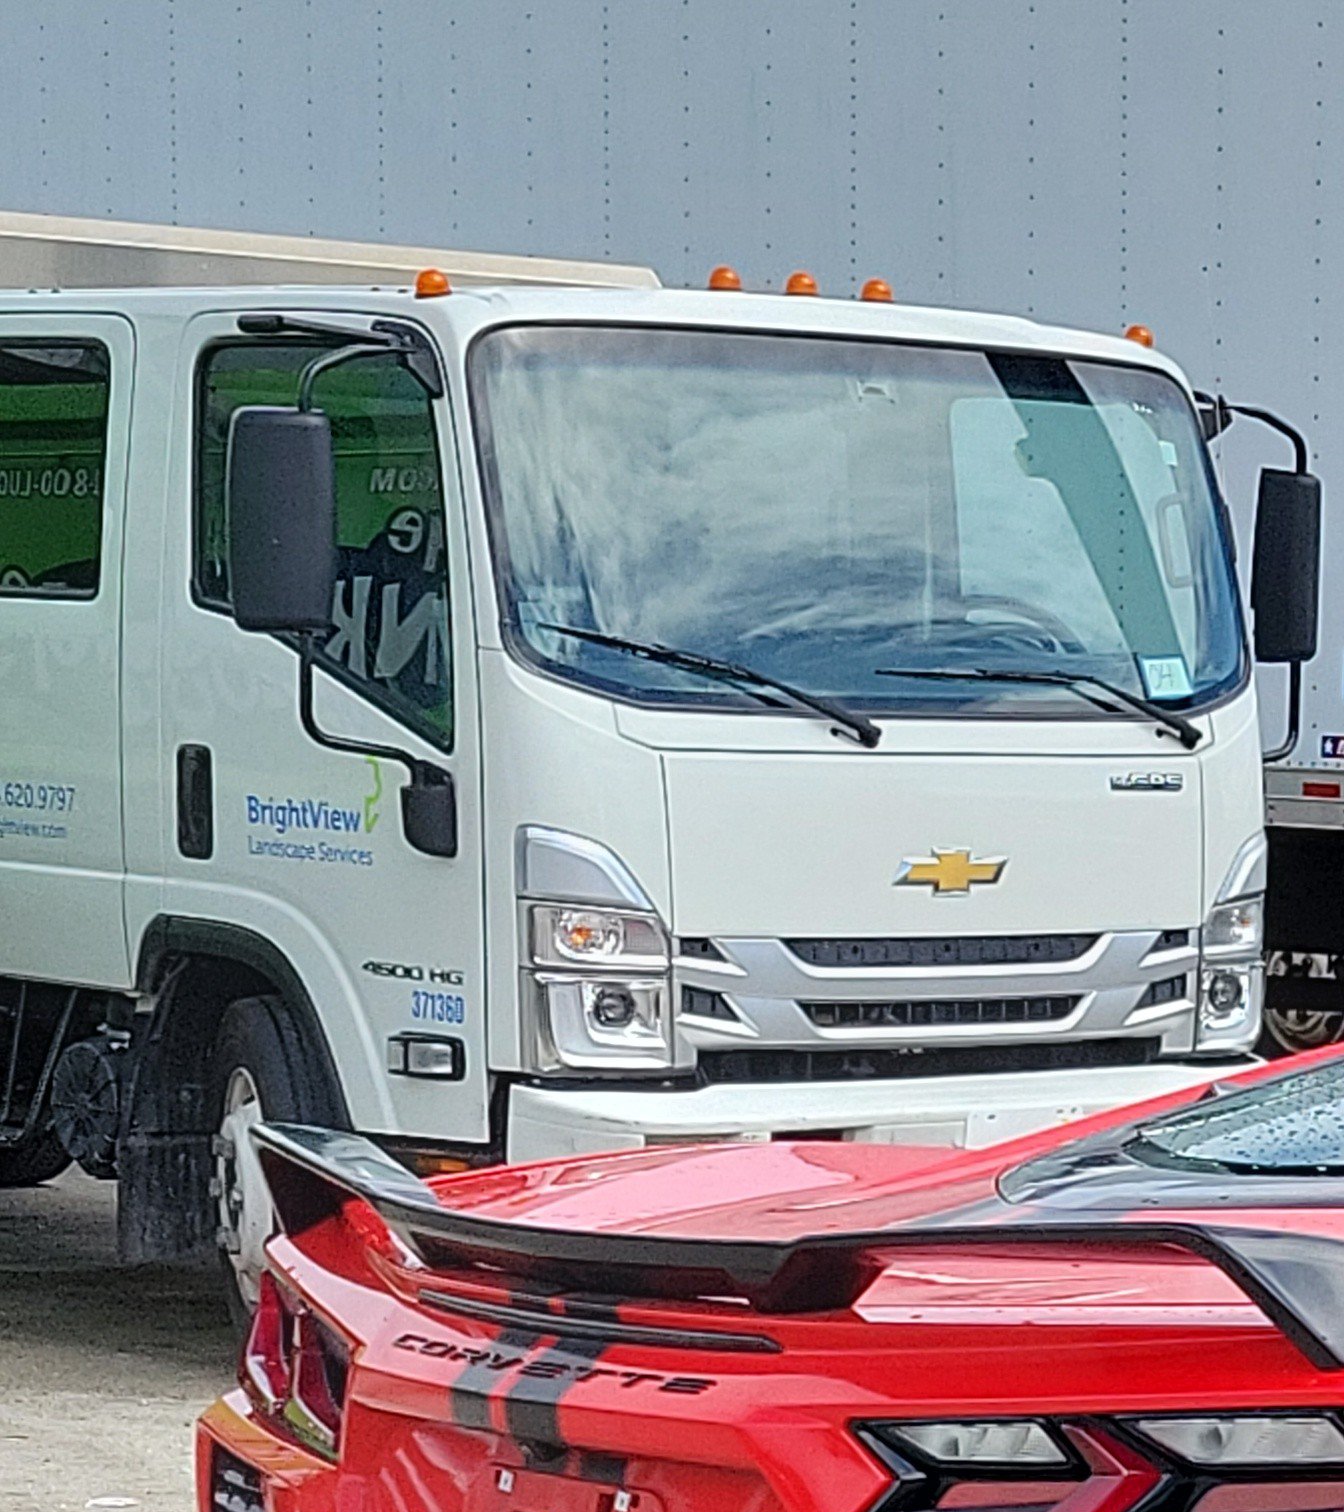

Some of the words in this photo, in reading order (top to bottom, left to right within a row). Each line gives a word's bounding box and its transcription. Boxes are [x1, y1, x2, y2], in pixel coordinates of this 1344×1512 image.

[246, 795, 361, 834] BrightView
[247, 835, 315, 860] Landscape
[318, 841, 373, 866] Services
[362, 961, 424, 981] 4500
[429, 967, 465, 986] HG
[393, 1333, 717, 1395] CORVETTE
